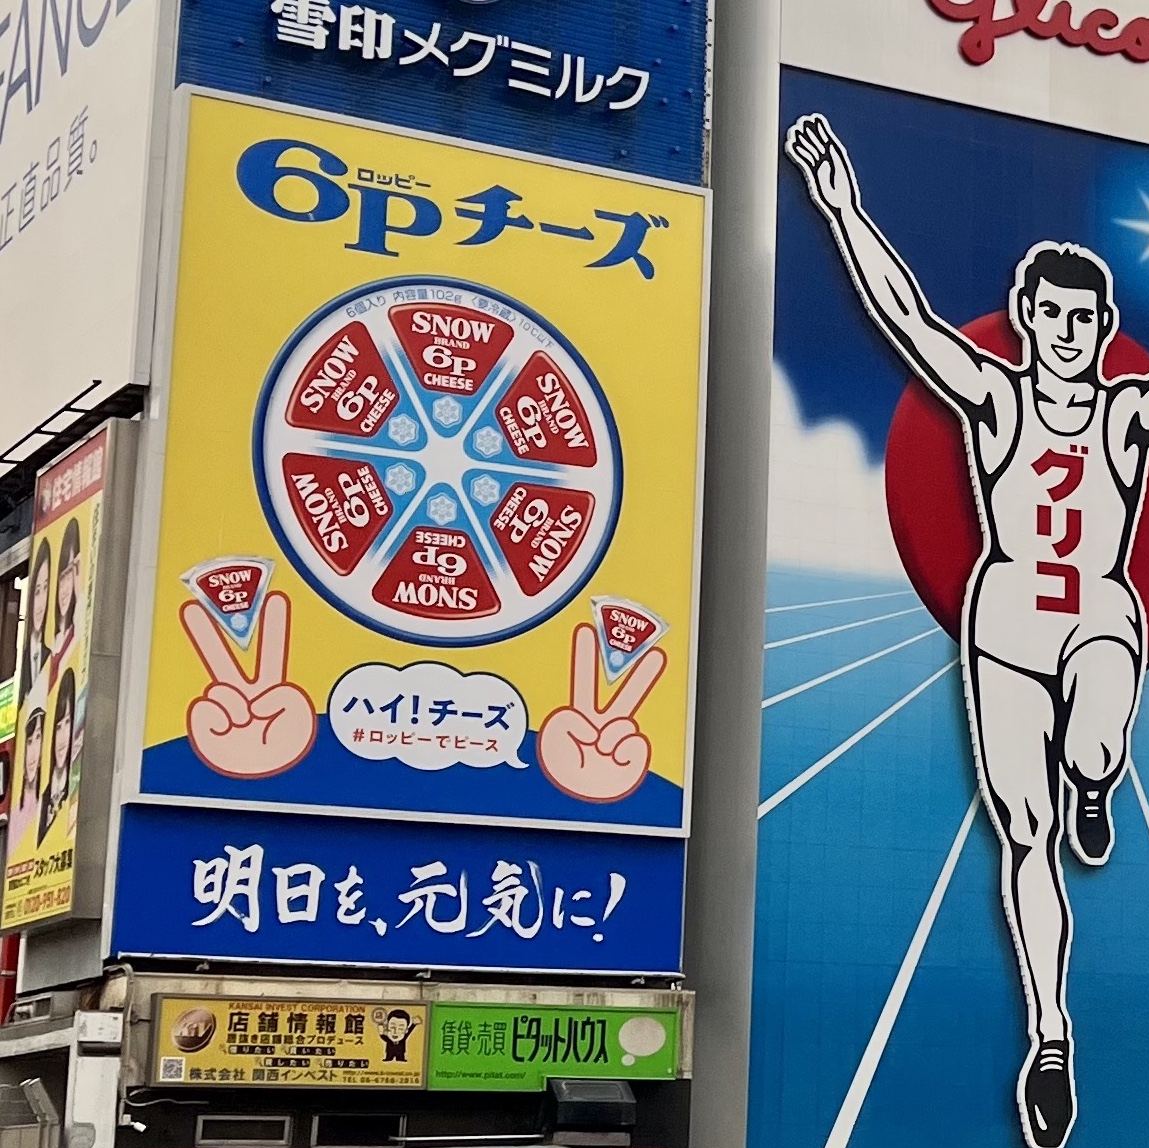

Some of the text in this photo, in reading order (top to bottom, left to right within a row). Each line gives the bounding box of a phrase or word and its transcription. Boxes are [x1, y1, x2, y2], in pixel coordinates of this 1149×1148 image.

[272, 0, 650, 110] 雪印メグミルク
[357, 167, 432, 190] ロッピー
[412, 312, 495, 343] SNOW
[300, 335, 359, 414] SNOW
[423, 345, 476, 376] 6P
[424, 373, 473, 391] CHEESE
[536, 373, 589, 448] SNOW
[291, 474, 349, 552] SNOW
[529, 505, 582, 582] SNOW
[1031, 445, 1088, 615] グリコ
[209, 570, 251, 587] SNOW
[392, 581, 478, 610] SNOW
[610, 609, 649, 631] SNOW
[343, 694, 515, 730] ハイ!チーズ
[353, 728, 499, 752] #ロッピーでピース
[227, 1011, 365, 1034] 店舗情報館
[300, 1004, 366, 1013] CORPORATION
[512, 1015, 608, 1064] ピタットハウス
[189, 1068, 245, 1081] 株式会社
[252, 1068, 338, 1082] 関西インベスト
